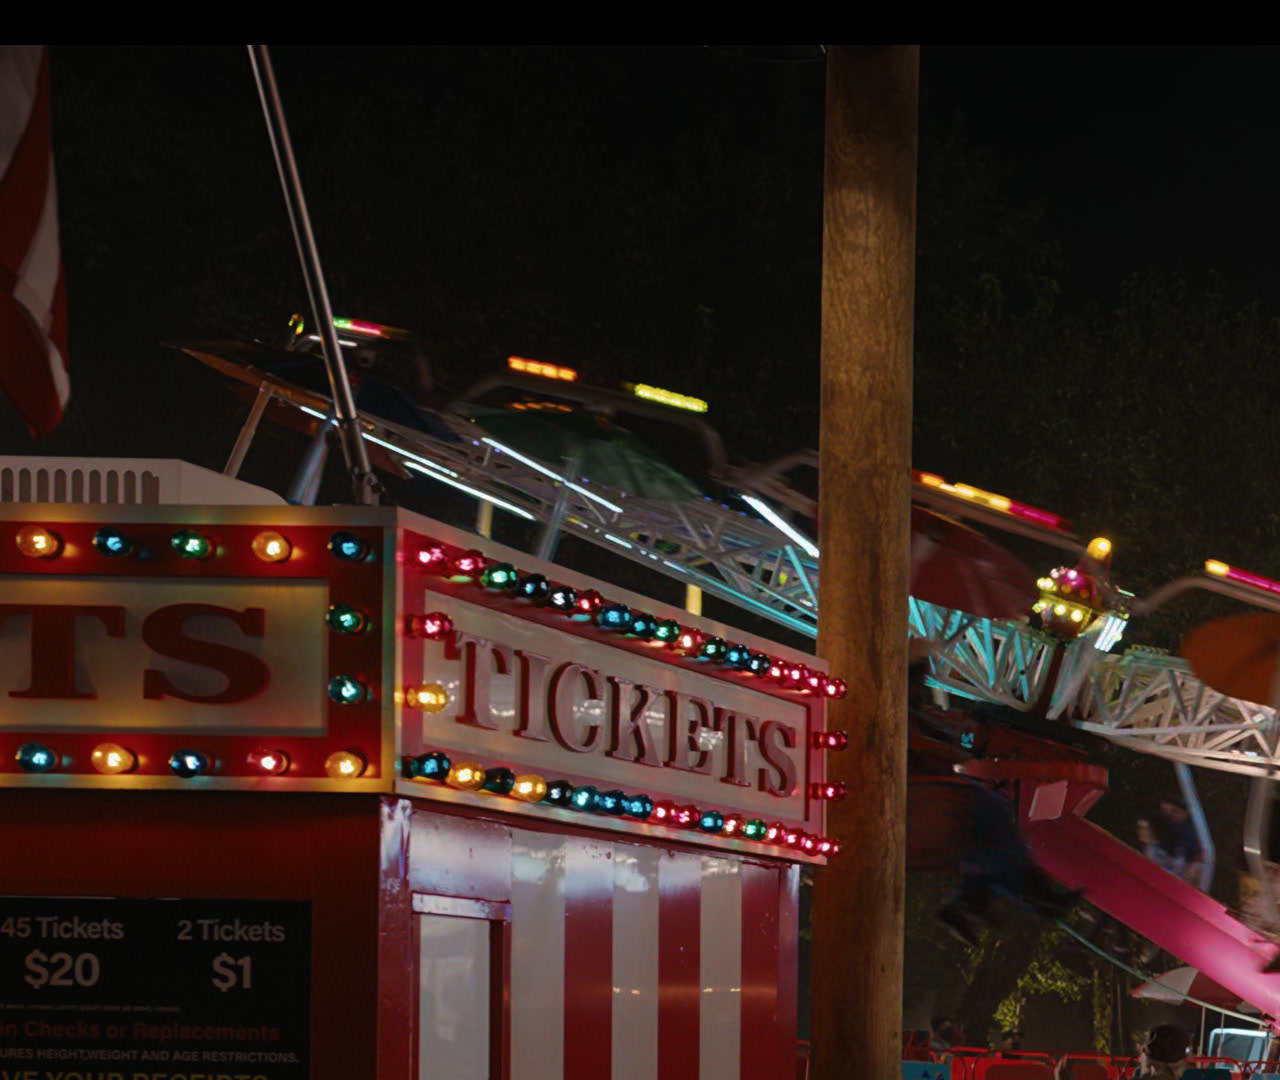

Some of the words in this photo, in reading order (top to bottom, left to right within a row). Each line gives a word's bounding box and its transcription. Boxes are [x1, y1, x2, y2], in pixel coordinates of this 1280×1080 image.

[0, 602, 271, 705] TS
[446, 630, 798, 798] TICKETS
[0, 917, 31, 938] 45
[36, 915, 125, 940] Tickets
[176, 919, 193, 941] 2
[197, 918, 286, 943] Tickets
[23, 948, 101, 990] $20
[210, 952, 253, 992] $1
[24, 1019, 101, 1040] Checks
[106, 1024, 126, 1040] or
[133, 1021, 280, 1043] Replacements
[141, 1050, 169, 1063] AND
[172, 1051, 200, 1063] AGE
